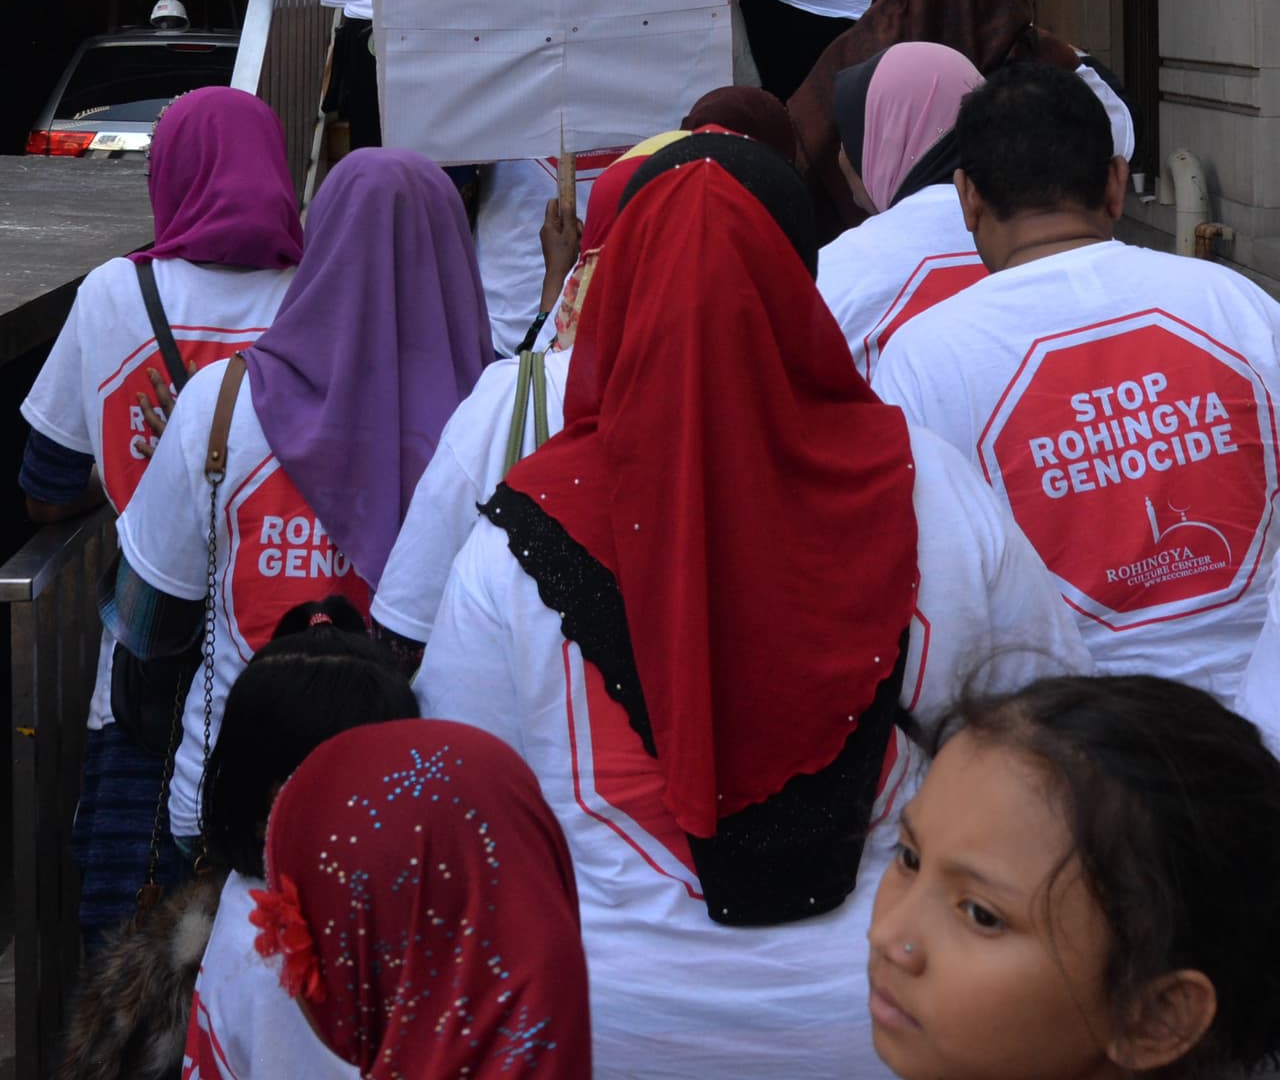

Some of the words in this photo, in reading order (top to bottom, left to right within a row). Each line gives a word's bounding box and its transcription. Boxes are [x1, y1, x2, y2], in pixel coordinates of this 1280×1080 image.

[1071, 372, 1168, 423] STOP
[1029, 392, 1230, 468] ROHINGYA
[1041, 423, 1239, 499] GENOCIDE
[1105, 545, 1194, 582] ROHINGYA
[1127, 565, 1169, 587] CULTURE
[1171, 554, 1212, 574] CENTER
